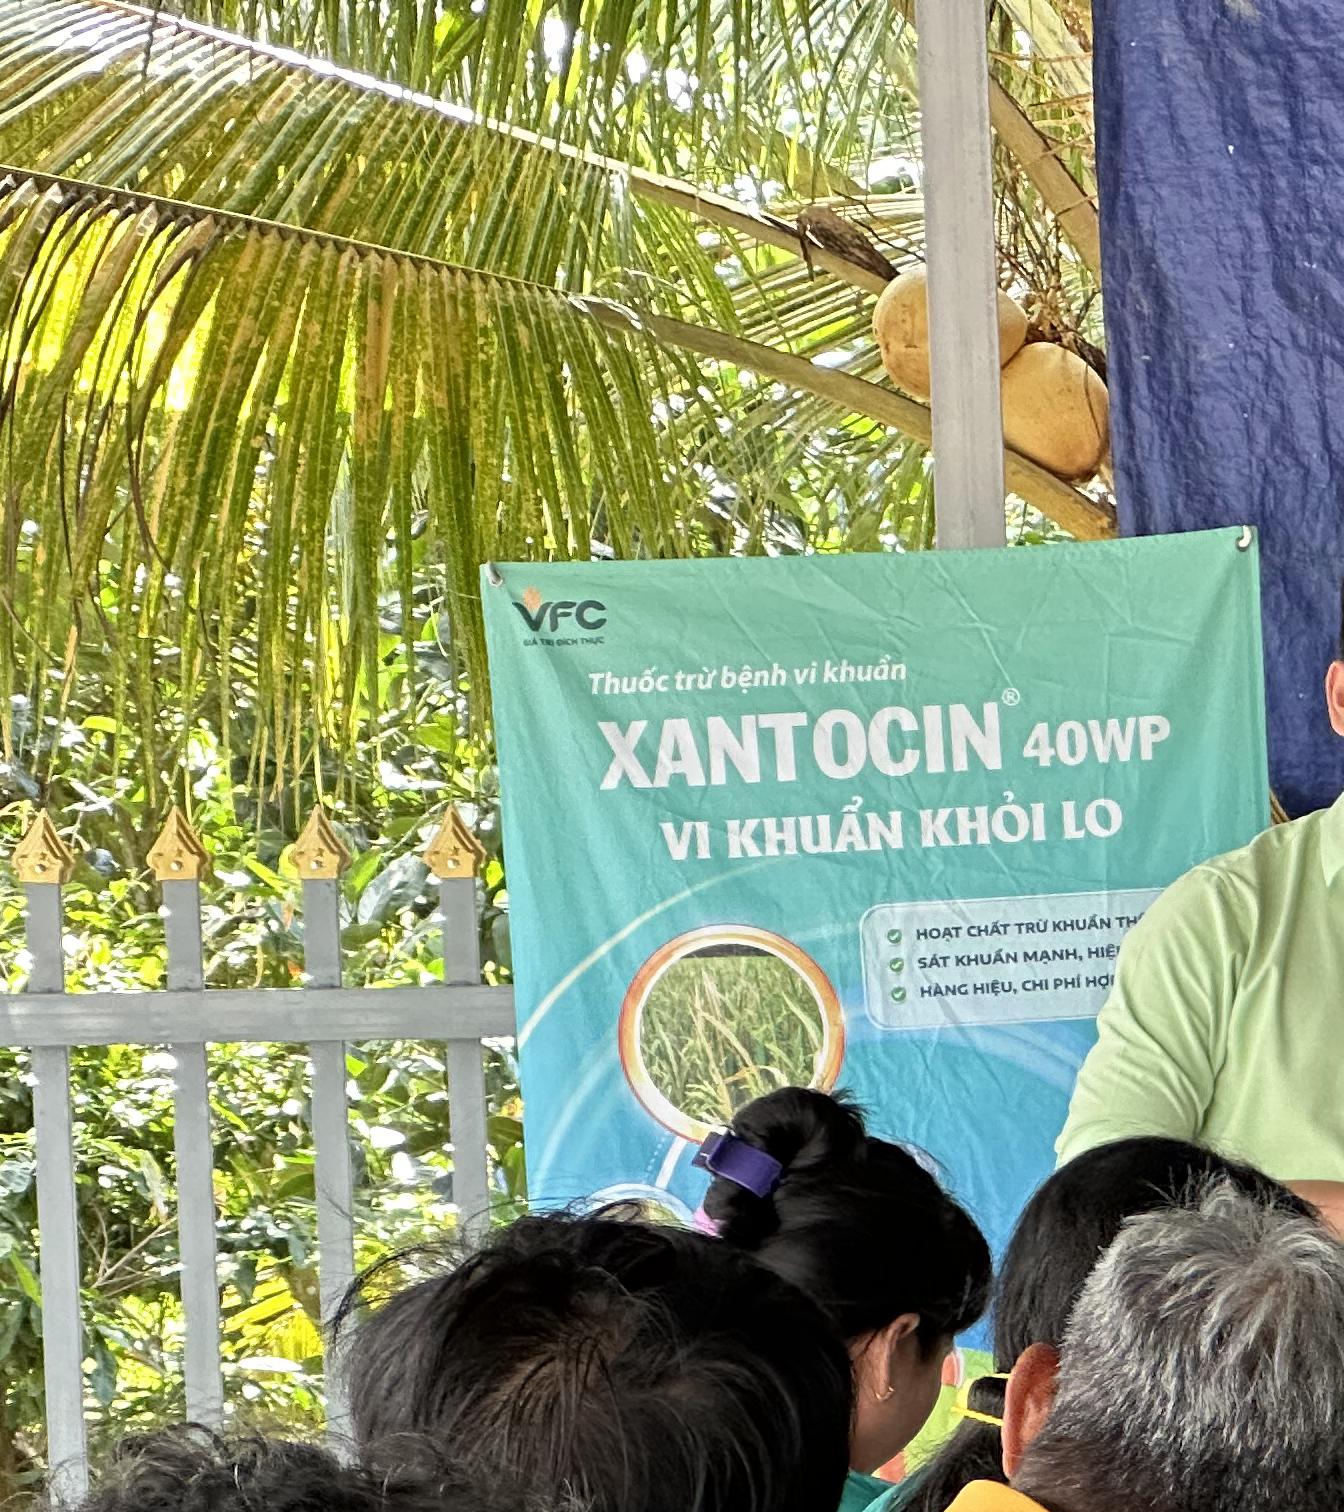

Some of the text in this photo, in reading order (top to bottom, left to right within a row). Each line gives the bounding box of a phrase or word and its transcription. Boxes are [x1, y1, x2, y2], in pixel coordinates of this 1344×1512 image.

[511, 600, 608, 632] VFC
[588, 653, 908, 696] Thuốc trừ bệnh vi khuẩn
[1022, 715, 1172, 767] 40WP
[658, 791, 1124, 860] VI KHUẨN KHỎI LO
[916, 926, 962, 942] HOẠT
[966, 919, 1012, 938] CHẤT
[1015, 918, 1049, 935] TRỪ
[917, 953, 950, 969] SÁT
[1023, 947, 1083, 965] MẠNH,
[920, 981, 968, 998] HÀNG
[973, 979, 1018, 996] HIỆU,
[1021, 977, 1049, 992] CHI
[1053, 973, 1081, 990] PHÍ
